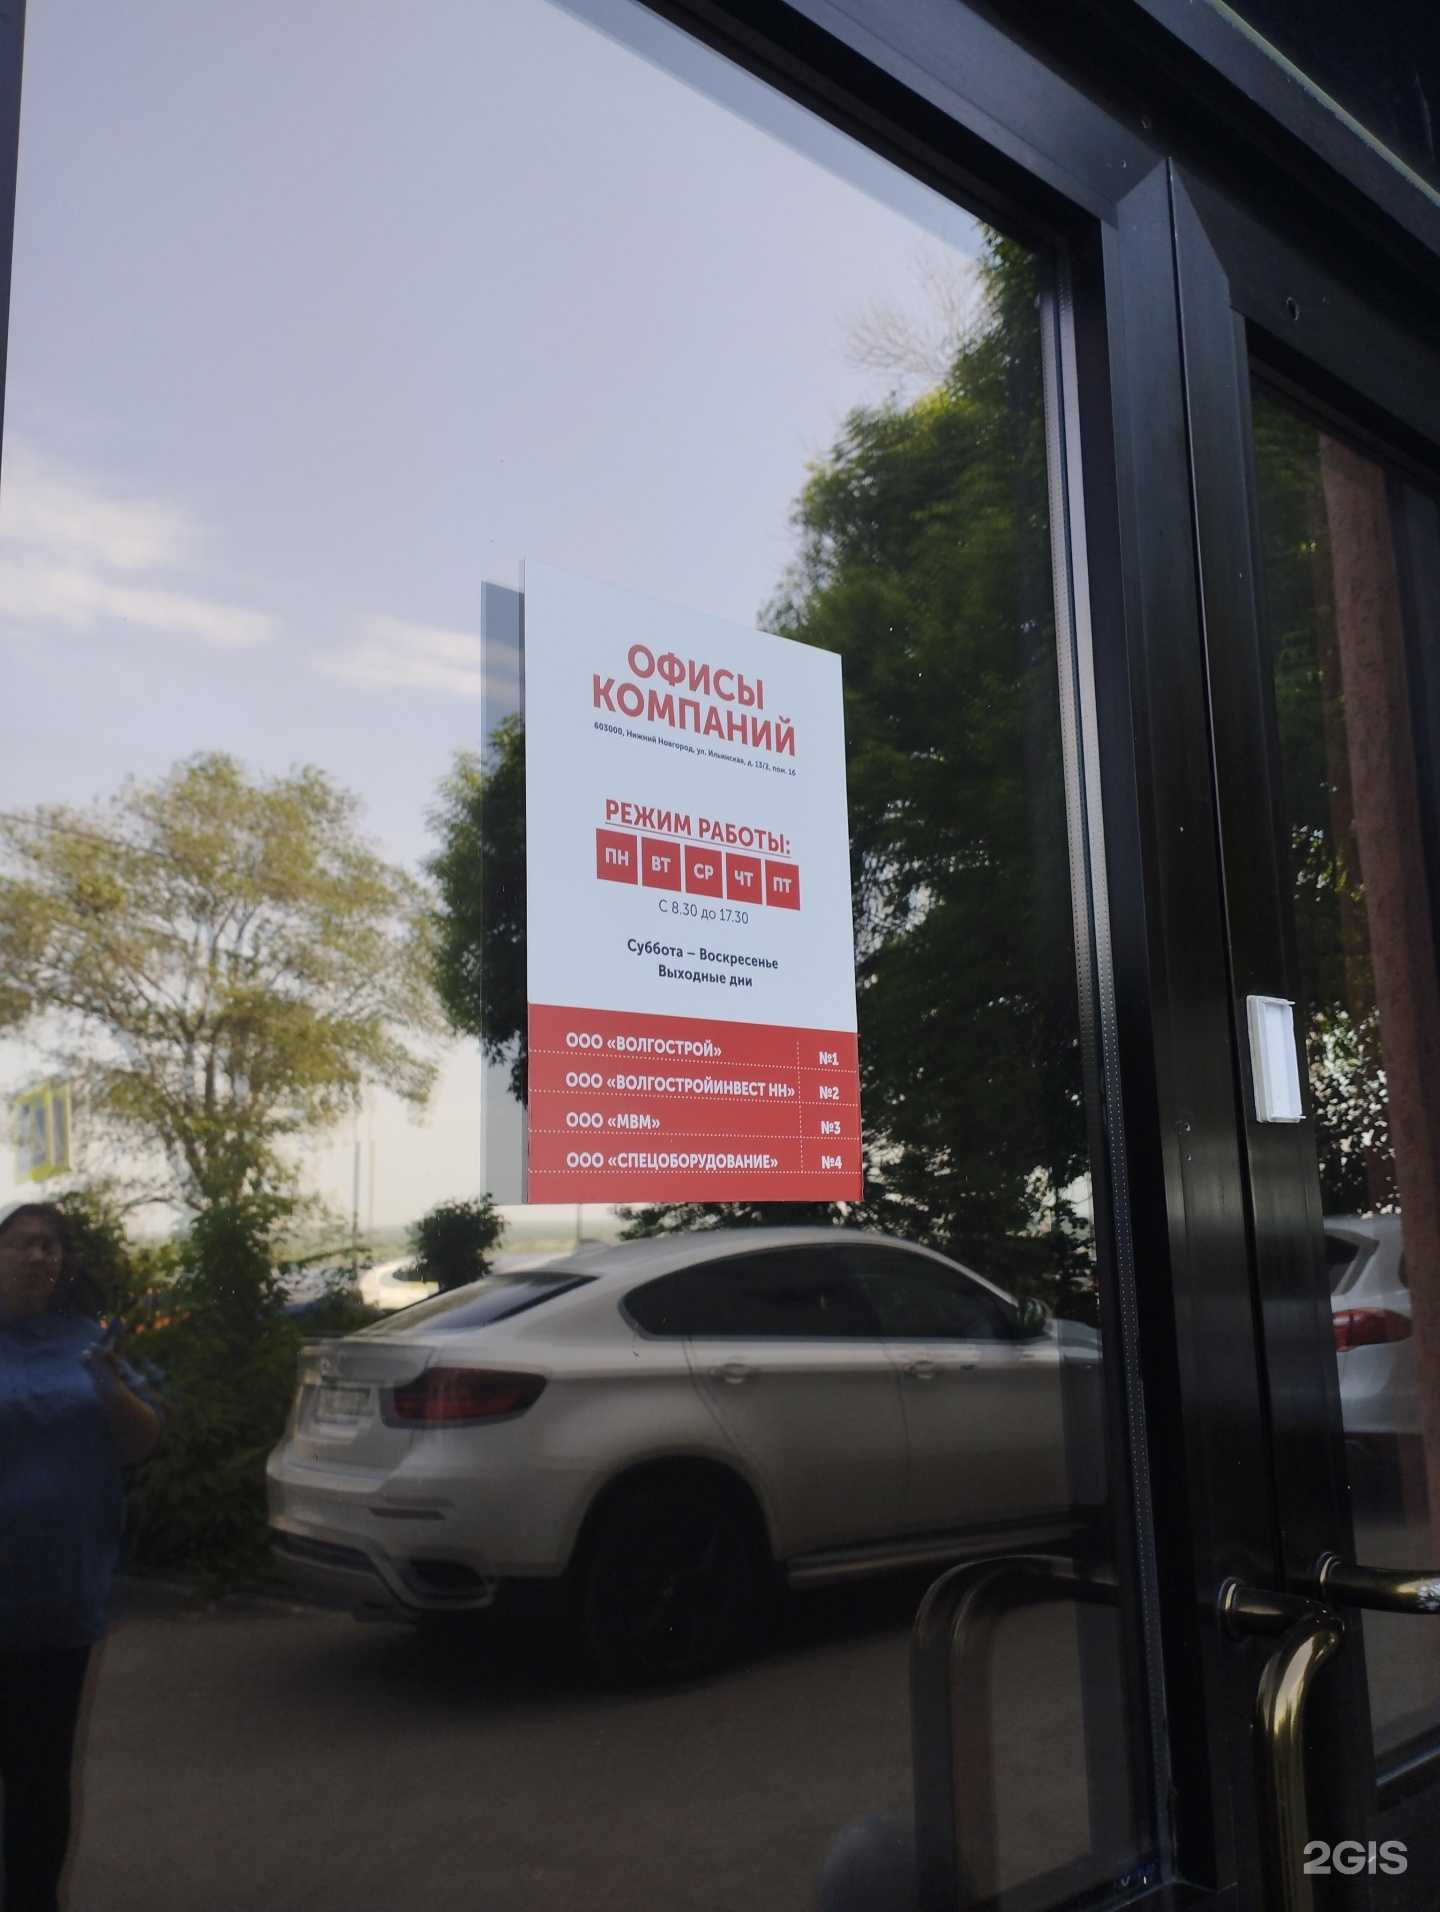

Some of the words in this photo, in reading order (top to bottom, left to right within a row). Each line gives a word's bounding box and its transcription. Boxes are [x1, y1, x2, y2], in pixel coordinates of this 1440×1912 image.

[627, 644, 764, 710] ОФИСЫ
[593, 673, 796, 757] КОМПАНИЙ
[593, 721, 625, 737] 603000,
[626, 729, 657, 744] Нижний
[658, 736, 695, 753] Новгород,
[605, 799, 691, 836] РЕЖИМ
[698, 819, 791, 855] РАБОТЫ:
[605, 847, 629, 866] ПН
[651, 856, 671, 873] ВТ
[693, 864, 714, 880] СР
[734, 870, 753, 887] ЧТ
[772, 877, 792, 893] ПТ
[658, 899, 667, 913] С
[671, 901, 698, 917] 8.30
[701, 908, 716, 921] до
[719, 908, 749, 924] 17.30
[627, 938, 683, 957] Суббота
[699, 948, 778, 969] Воскресенье
[658, 965, 726, 985] Выходные
[729, 974, 753, 988] дни
[566, 1032, 603, 1049] ООО
[606, 1035, 722, 1057] «ВОЛГОСТРОЙ»
[819, 1051, 839, 1066] №1
[566, 1071, 603, 1088] ООО
[606, 1074, 766, 1097] «ВОЛГОСТРОЙИНВЕСТ
[768, 1083, 795, 1098] НН»
[819, 1086, 840, 1100] №2
[566, 1111, 604, 1128] ООО
[607, 1113, 661, 1130] «МВМ»
[821, 1120, 841, 1134] №3
[566, 1151, 604, 1168] ООО
[607, 1152, 779, 1171] «СПЕЦОБОРУДОВАНИЕ»
[821, 1155, 842, 1170] №4
